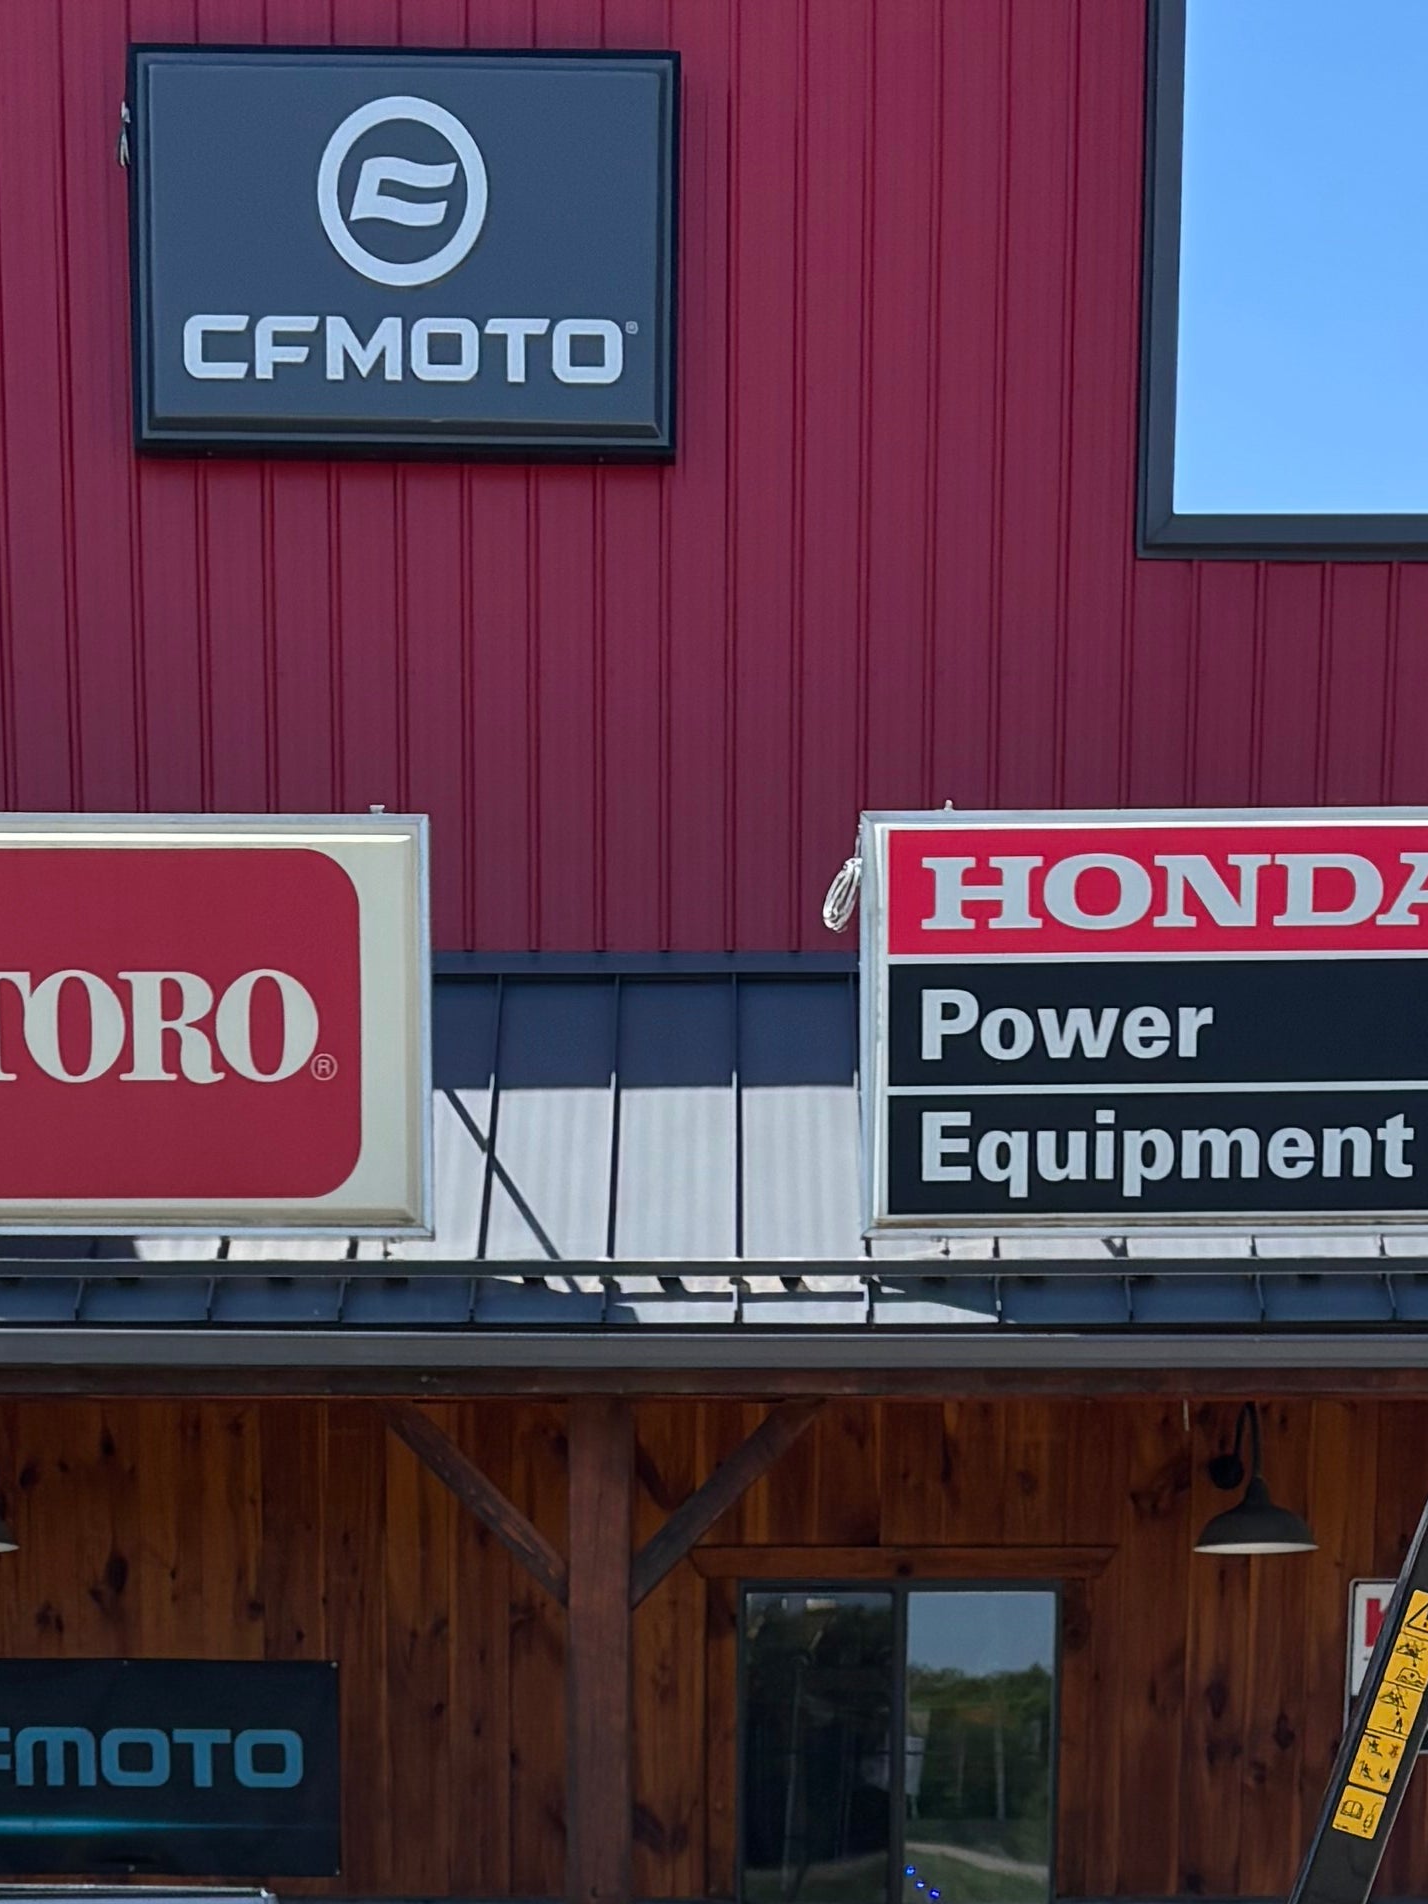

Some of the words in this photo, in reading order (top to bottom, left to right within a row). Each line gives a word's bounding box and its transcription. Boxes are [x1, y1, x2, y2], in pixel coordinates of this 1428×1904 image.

[182, 313, 624, 385] CFMOTO
[920, 988, 1214, 1061] Power
[920, 1109, 1415, 1199] Equipment
